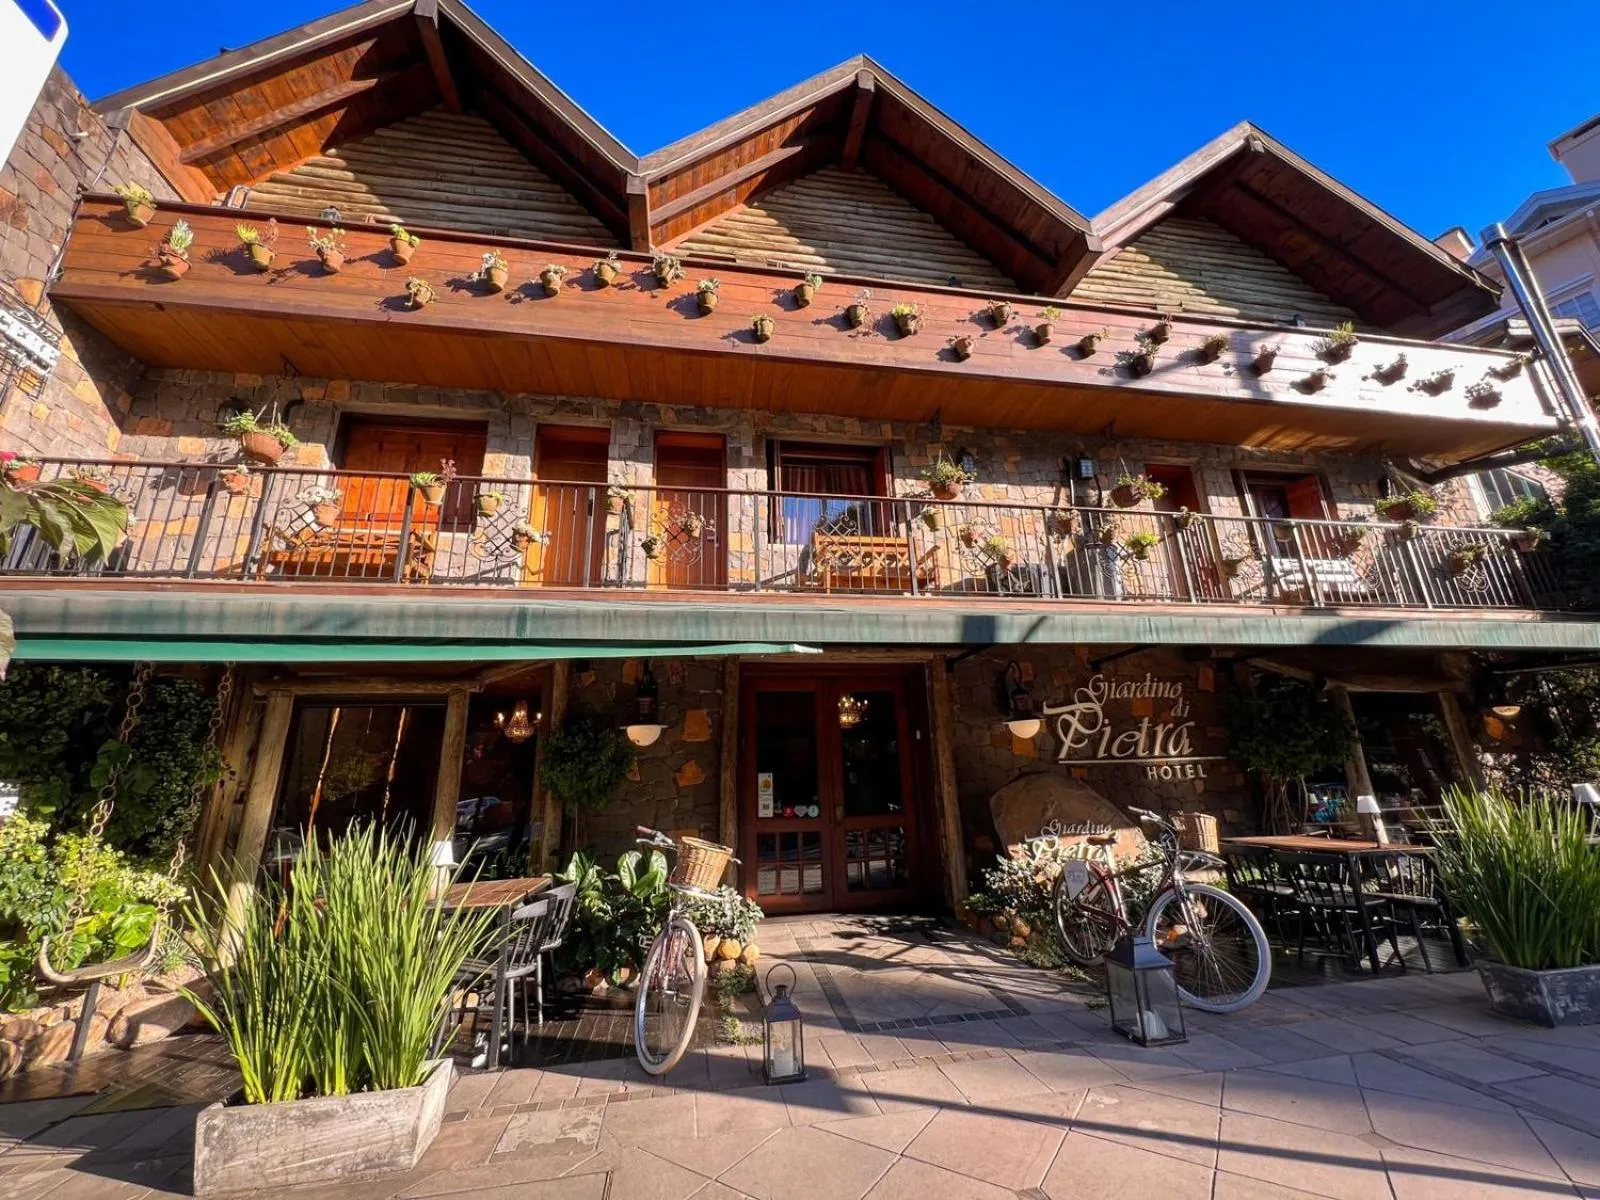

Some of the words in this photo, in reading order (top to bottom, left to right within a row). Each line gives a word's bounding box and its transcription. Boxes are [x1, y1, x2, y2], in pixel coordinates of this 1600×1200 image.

[1075, 673, 1182, 705] Giardino
[1171, 697, 1190, 717] di
[1043, 701, 1195, 758] Pietra
[1147, 764, 1208, 781] HOTEL
[1041, 819, 1112, 837] Giardino
